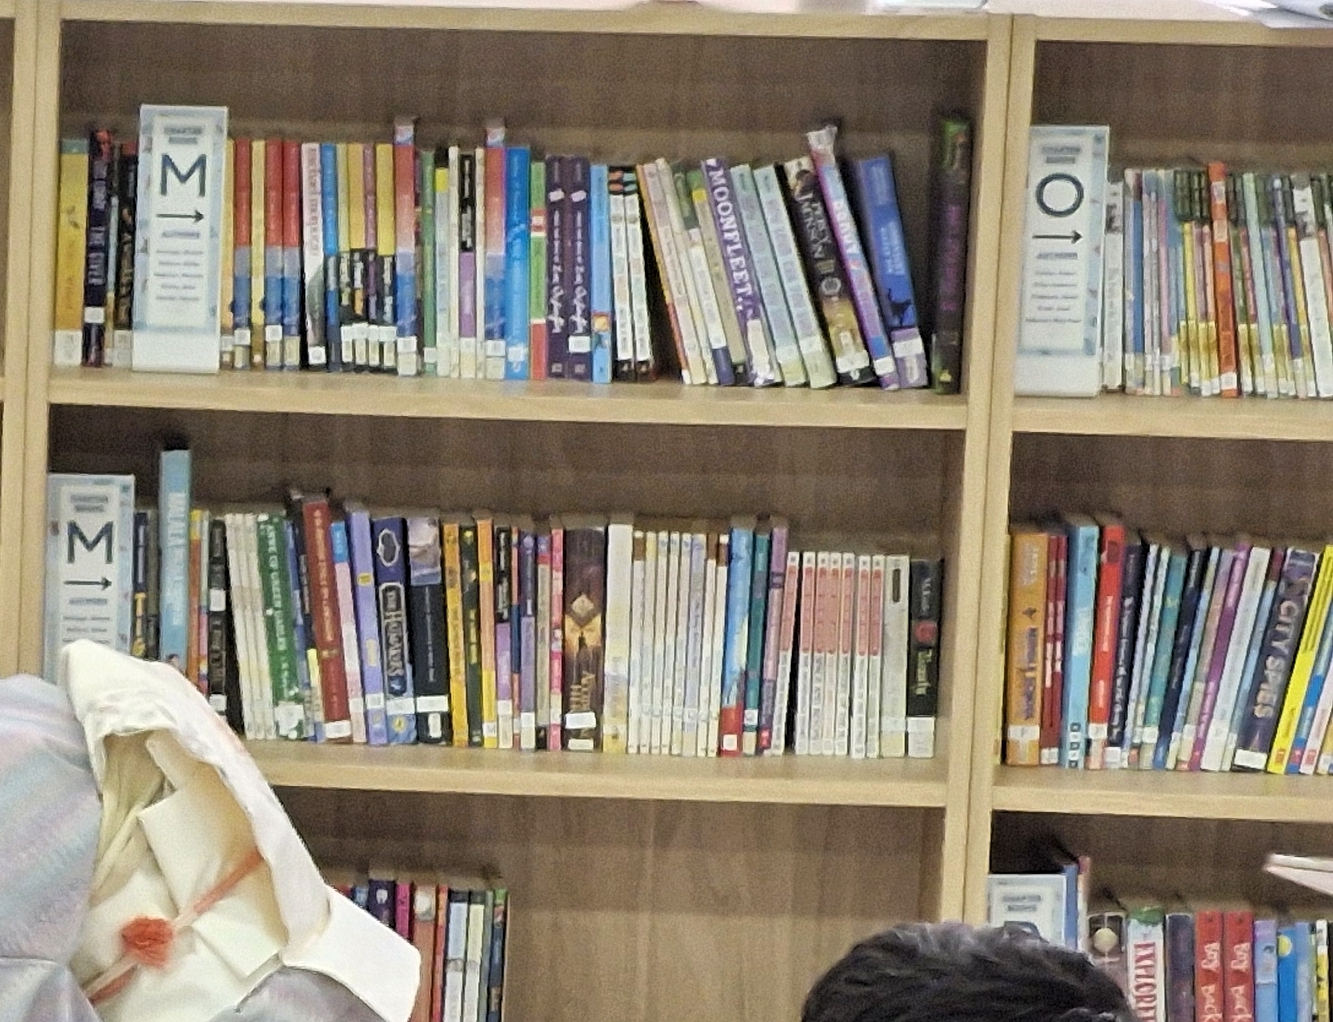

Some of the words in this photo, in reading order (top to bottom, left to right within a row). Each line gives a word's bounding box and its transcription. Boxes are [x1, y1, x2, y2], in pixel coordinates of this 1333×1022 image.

[160, 153, 207, 197] M
[1035, 172, 1085, 218] O
[796, 194, 824, 260] JACKSON
[67, 520, 113, 565] M
[167, 492, 189, 546] MALALA
[270, 571, 284, 608] GREEN
[1269, 601, 1299, 654] CITY
[1254, 655, 1285, 719] SPIES
